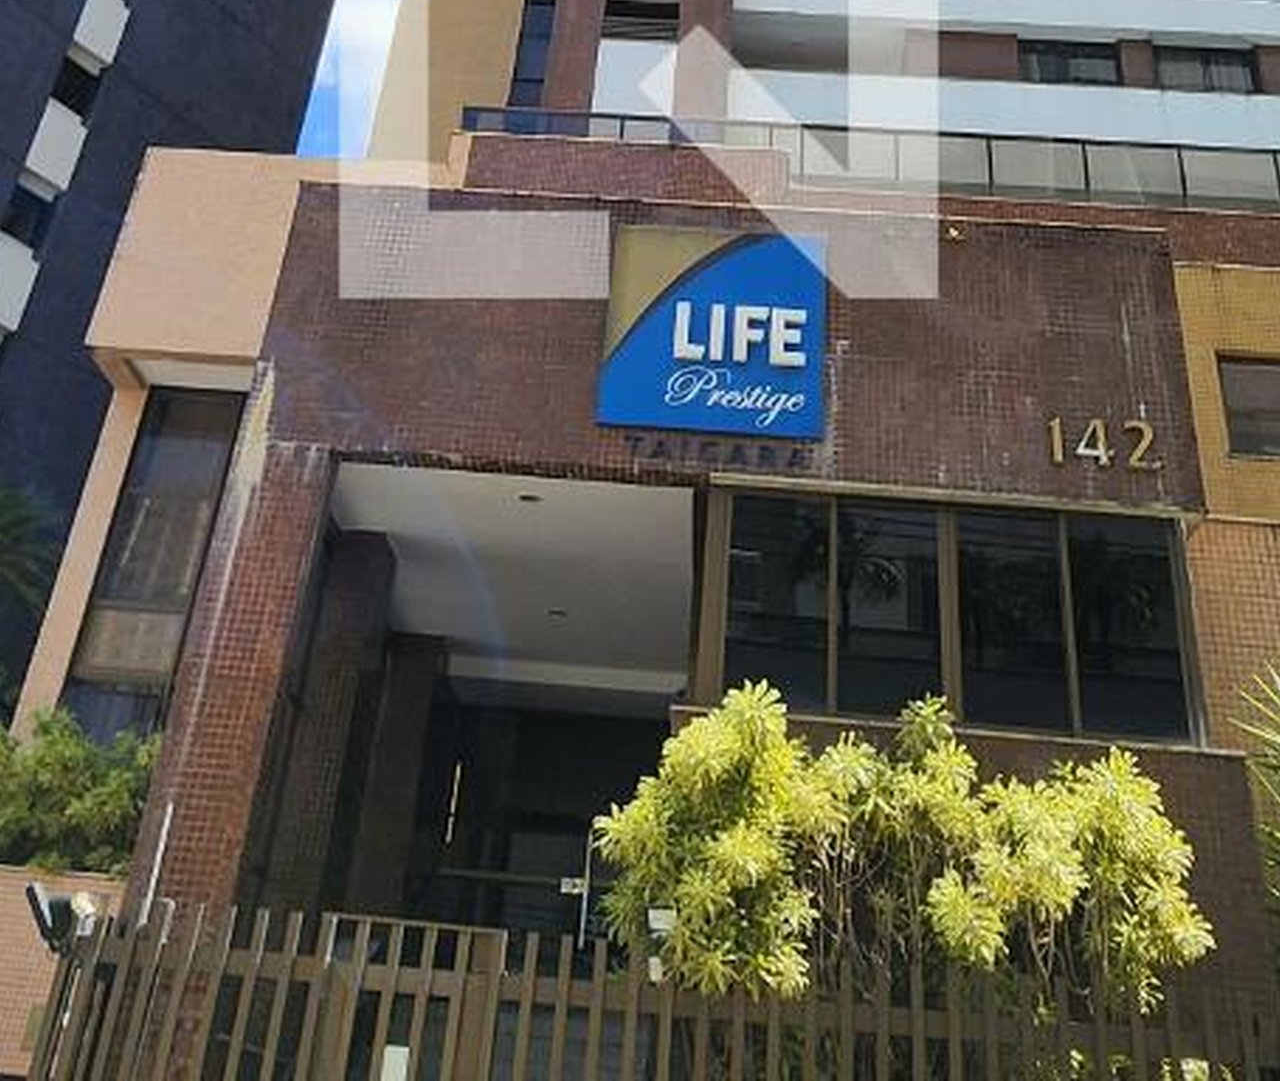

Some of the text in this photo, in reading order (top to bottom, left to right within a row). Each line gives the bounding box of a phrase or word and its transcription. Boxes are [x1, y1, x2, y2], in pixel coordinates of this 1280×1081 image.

[673, 301, 807, 366] LIFE
[664, 366, 805, 428] Prestige
[1048, 417, 1162, 468] 142
